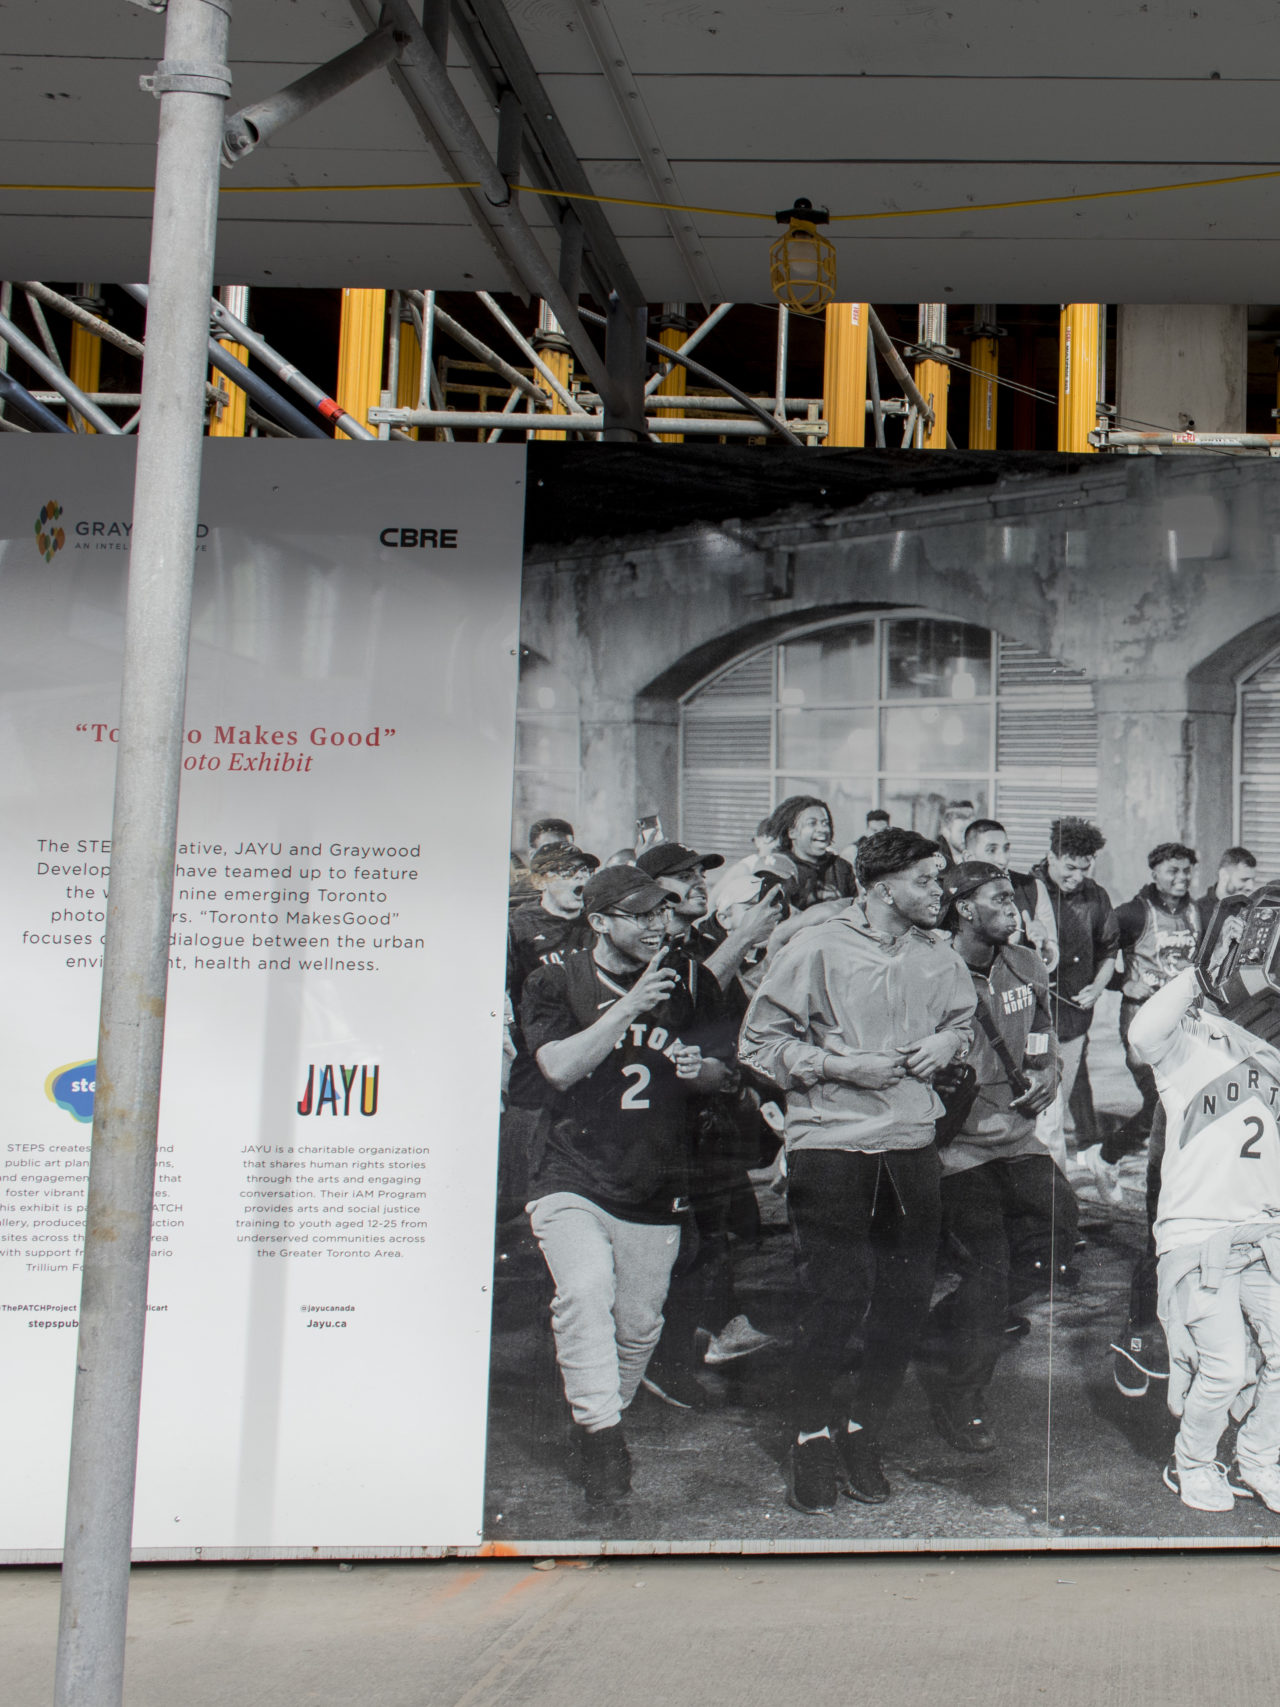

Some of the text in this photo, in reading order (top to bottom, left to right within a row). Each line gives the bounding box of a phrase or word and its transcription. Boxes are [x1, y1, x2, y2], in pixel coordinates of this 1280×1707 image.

[75, 521, 209, 538] GRAYD
[380, 528, 458, 549] CBRE
[214, 725, 298, 746] Makes
[183, 752, 313, 772] oto Exhibit
[36, 839, 70, 853] The
[76, 839, 113, 854] STE
[234, 842, 282, 856] JAYU
[288, 842, 322, 857] and
[329, 843, 421, 860] Graywood
[37, 862, 419, 881] Develop have teamed up to feature
[65, 885, 95, 899] the
[179, 886, 217, 901] nine
[223, 887, 310, 905] emerging
[317, 888, 388, 903] Toronto
[22, 930, 93, 945] focuses
[252, 933, 330, 948] between
[336, 934, 366, 949] the
[373, 935, 425, 949] urban
[194, 955, 251, 970] health
[257, 956, 291, 971] and
[298, 956, 379, 972] wellness.
[71, 1077, 97, 1093] ste
[621, 1063, 651, 1110] 2
[297, 1064, 380, 1117] JAYU
[1239, 1115, 1265, 1159] 2
[7, 1144, 46, 1152] STEPS
[240, 1145, 272, 1153] JAYU
[297, 1145, 356, 1154] charitable
[358, 1146, 430, 1155] organization
[4, 1159, 41, 1168] public
[242, 1160, 427, 1170] that shares human rights stories
[20, 1175, 90, 1185] engagemen
[158, 1174, 182, 1182] that
[246, 1175, 292, 1184] through
[295, 1175, 315, 1183] the
[367, 1176, 422, 1185] engaging
[5, 1188, 85, 1196] foster vibrant
[239, 1190, 316, 1198] conversation.
[319, 1190, 349, 1198] Their
[377, 1190, 427, 1200] Program
[19, 1203, 60, 1212] exhibit
[152, 1204, 183, 1212] ATCH
[244, 1204, 294, 1213] provides
[321, 1205, 344, 1213] and
[347, 1205, 380, 1213] social
[382, 1205, 421, 1214] justice
[235, 1219, 280, 1229] training
[298, 1220, 332, 1229] youth
[334, 1220, 364, 1229] aged
[367, 1220, 398, 1228] 12-25
[400, 1220, 428, 1228] from
[72, 1234, 85, 1242] th
[236, 1234, 309, 1242] underserved
[311, 1235, 386, 1243] communities
[24, 1249, 72, 1258] support
[256, 1249, 277, 1257] the
[279, 1249, 323, 1257] Greater
[325, 1249, 371, 1257] Toronto
[25, 1264, 69, 1272] Trillium
[306, 1320, 348, 1329] Jayu.ca
